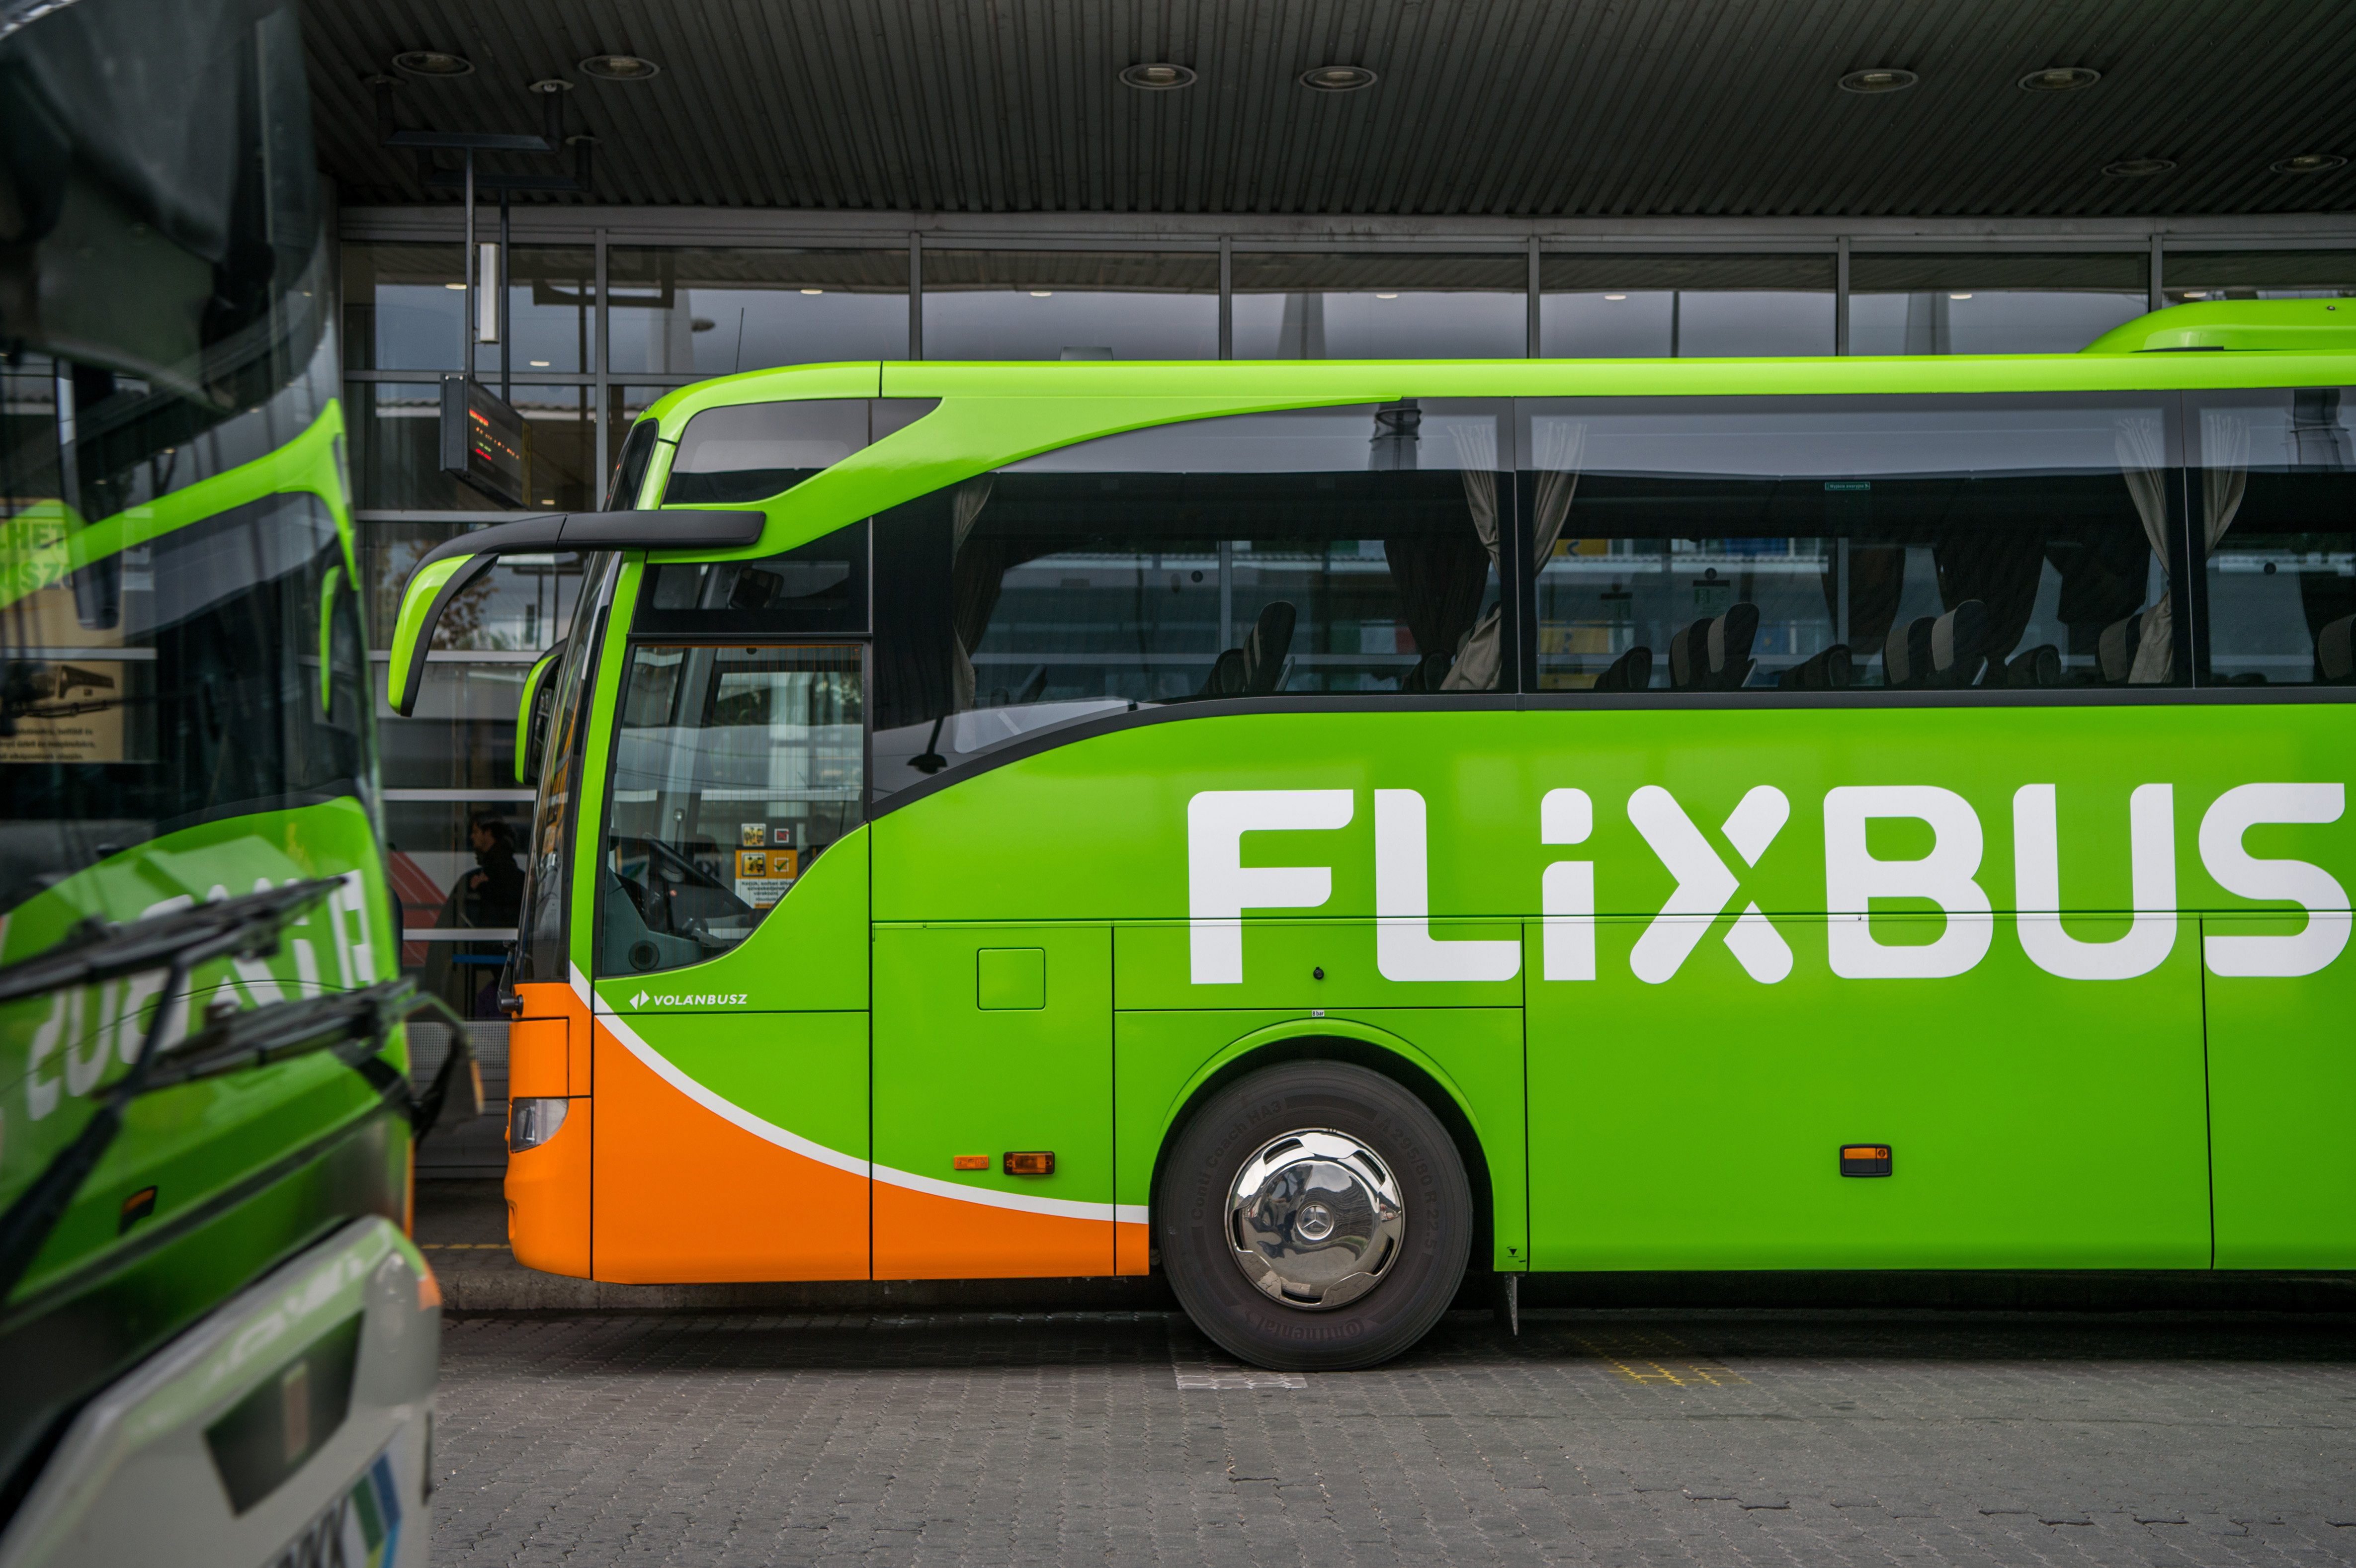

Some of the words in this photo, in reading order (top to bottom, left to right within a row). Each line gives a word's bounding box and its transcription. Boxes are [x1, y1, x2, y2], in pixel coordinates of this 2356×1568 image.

[1191, 1173, 1211, 1220] Conti
[1206, 1122, 1248, 1169] Coach
[1247, 1100, 1282, 1126] HA3
[1390, 1128, 1434, 1187] 295/80
[1424, 1208, 1439, 1249] 22.5
